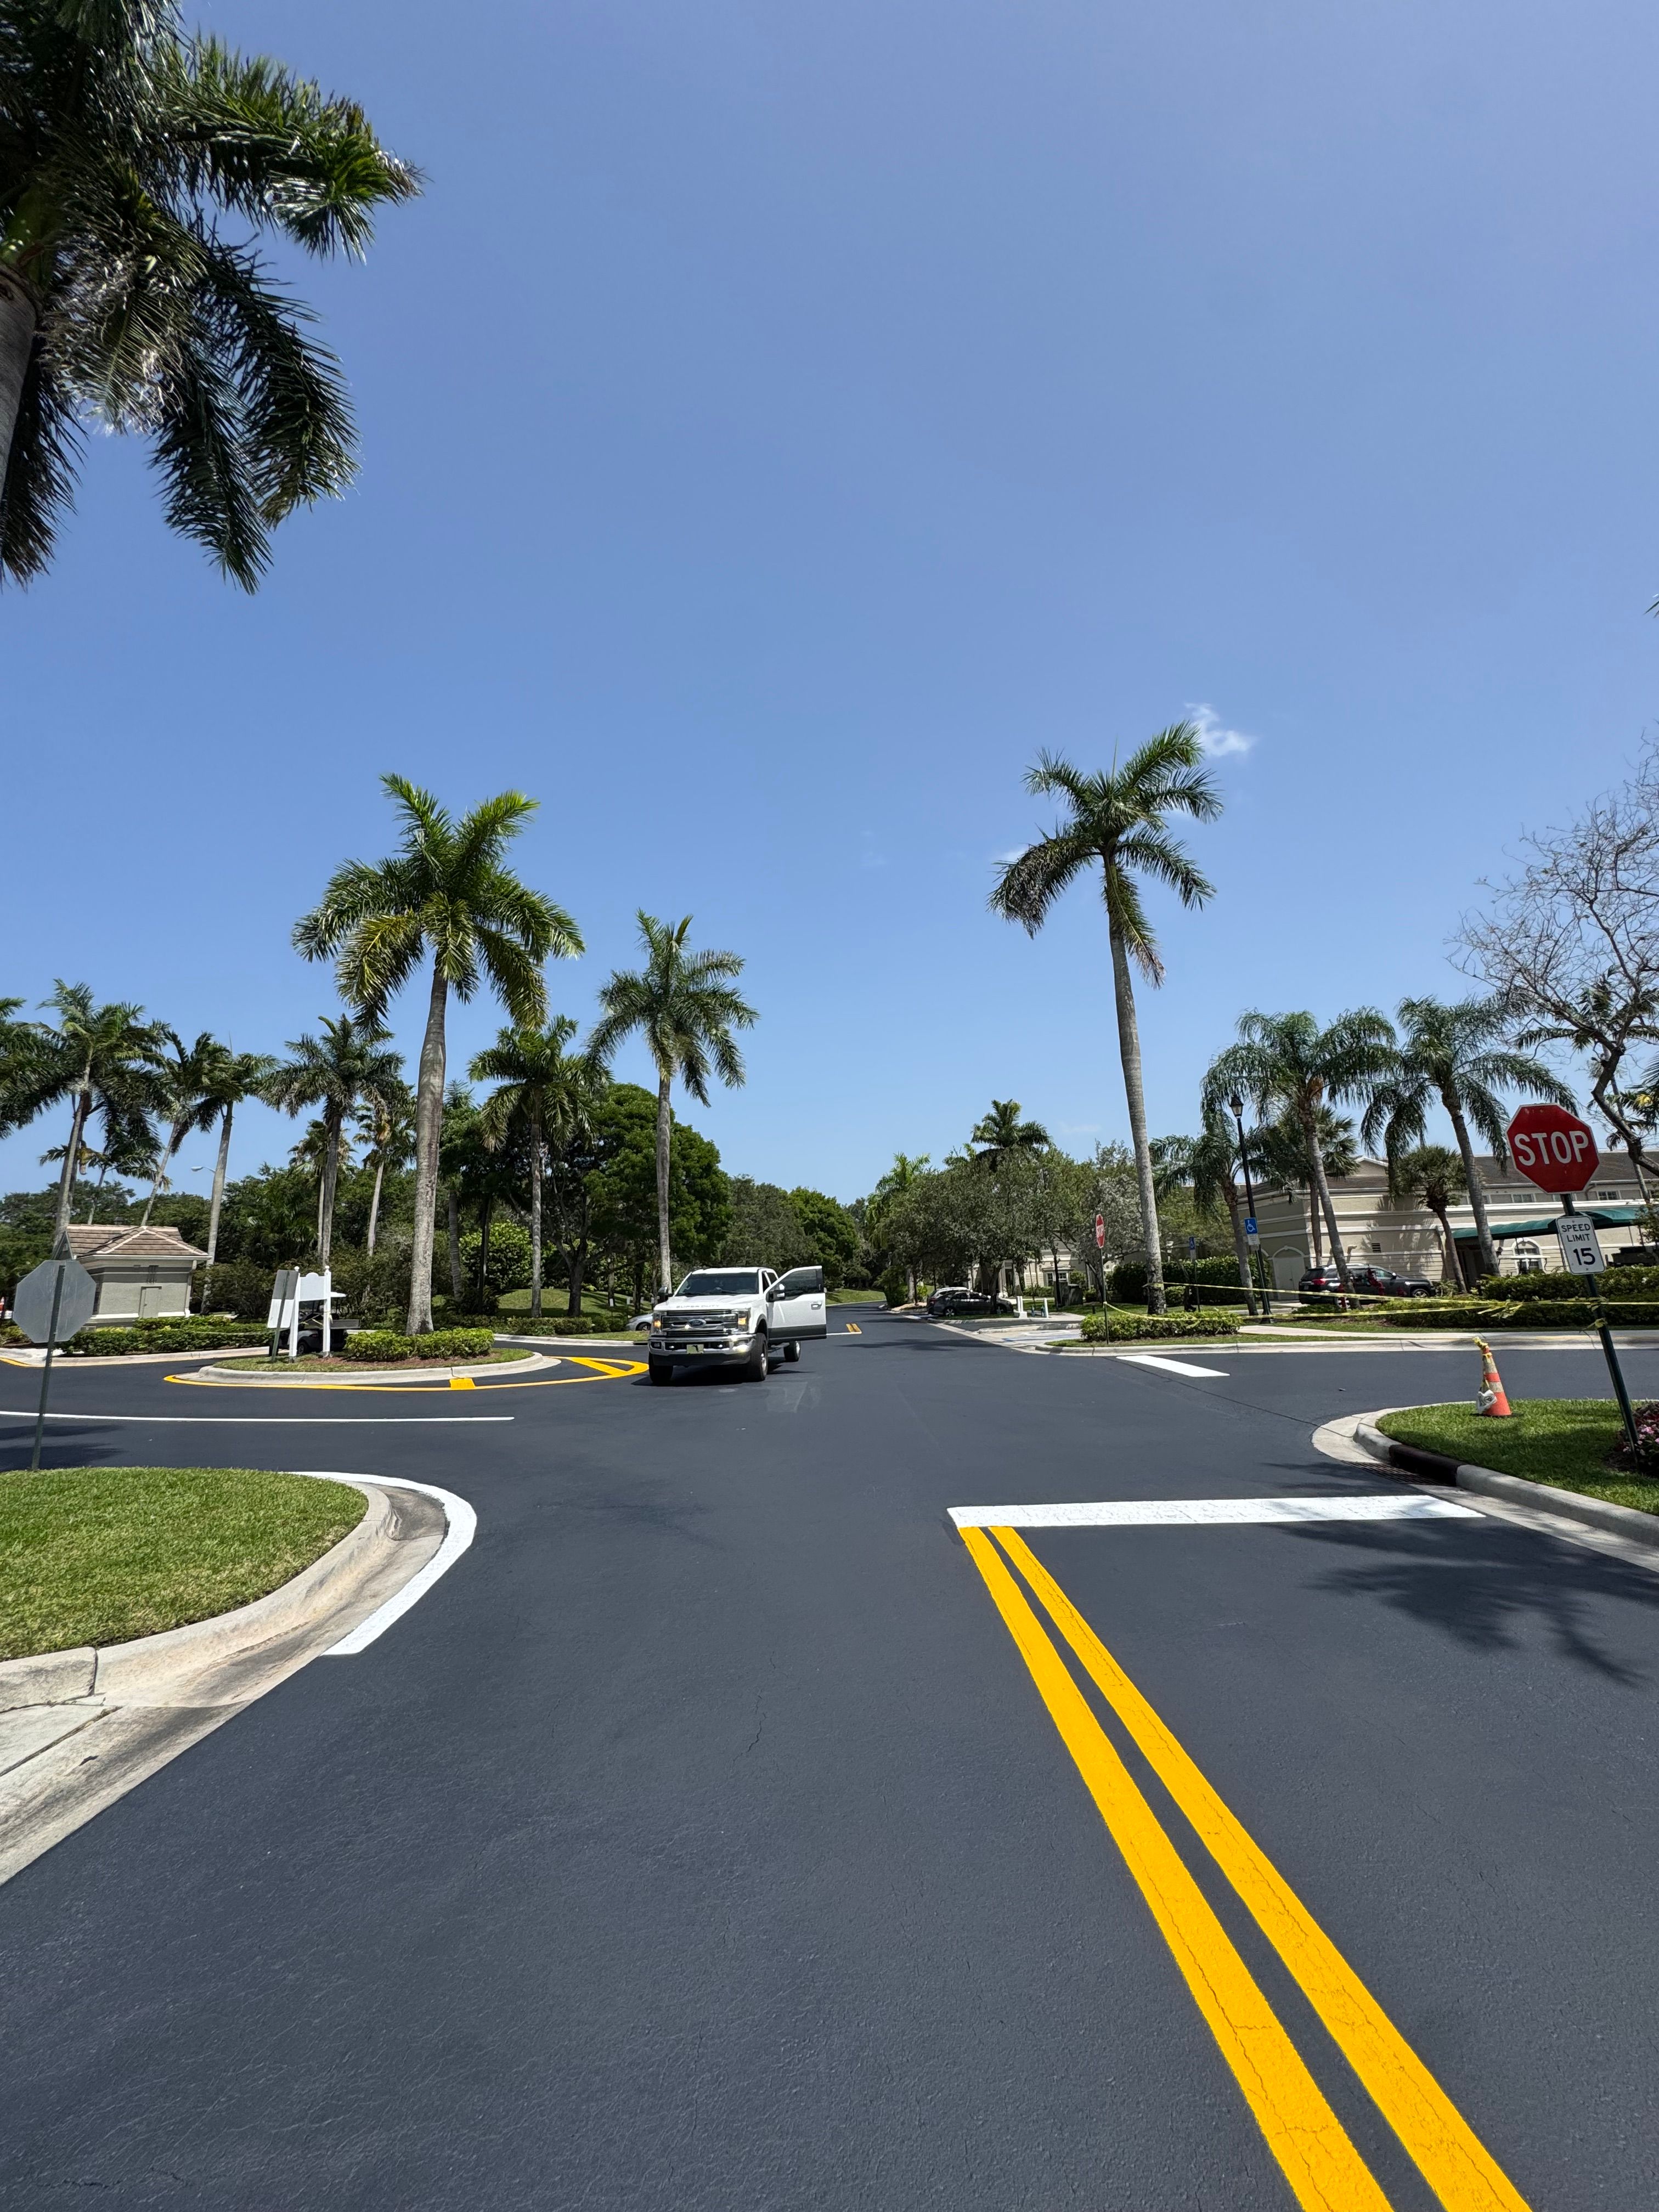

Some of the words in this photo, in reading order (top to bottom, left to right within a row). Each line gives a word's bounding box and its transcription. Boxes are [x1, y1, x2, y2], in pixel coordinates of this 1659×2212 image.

[1514, 1130, 1589, 1166] STOP
[1561, 1223, 1591, 1233] SPEED
[1566, 1233, 1590, 1243] LIMIT
[1573, 1247, 1596, 1266] 15
